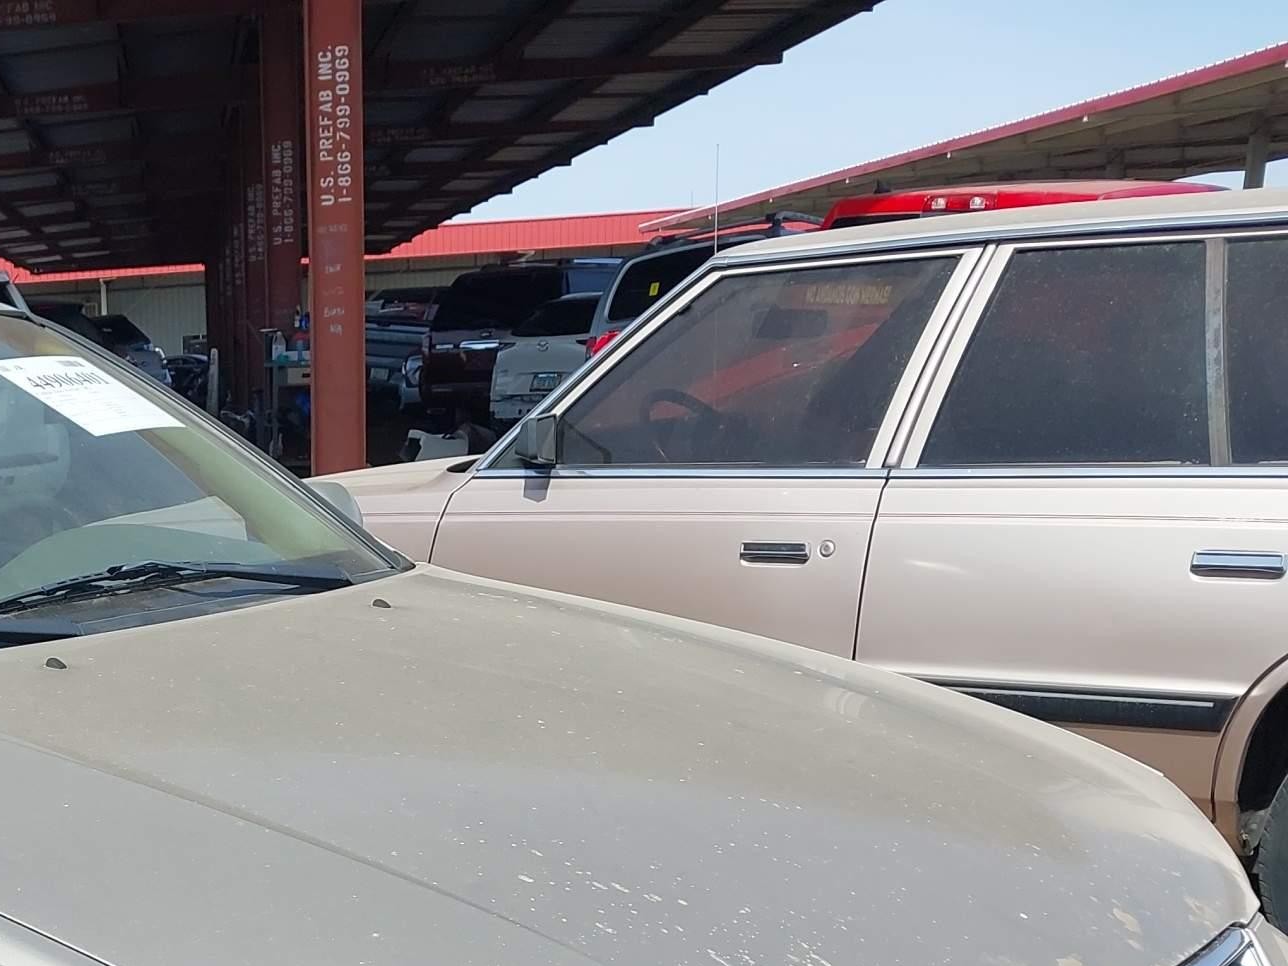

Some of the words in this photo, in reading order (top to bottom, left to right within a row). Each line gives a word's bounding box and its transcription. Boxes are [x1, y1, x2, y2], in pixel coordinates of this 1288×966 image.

[317, 44, 333, 80] INC.
[318, 89, 334, 161] PREFAB
[335, 45, 353, 202] 1-866-799-0969
[272, 169, 283, 216] PREFAB
[319, 170, 335, 206] U.S.
[26, 371, 110, 390] 44906401
